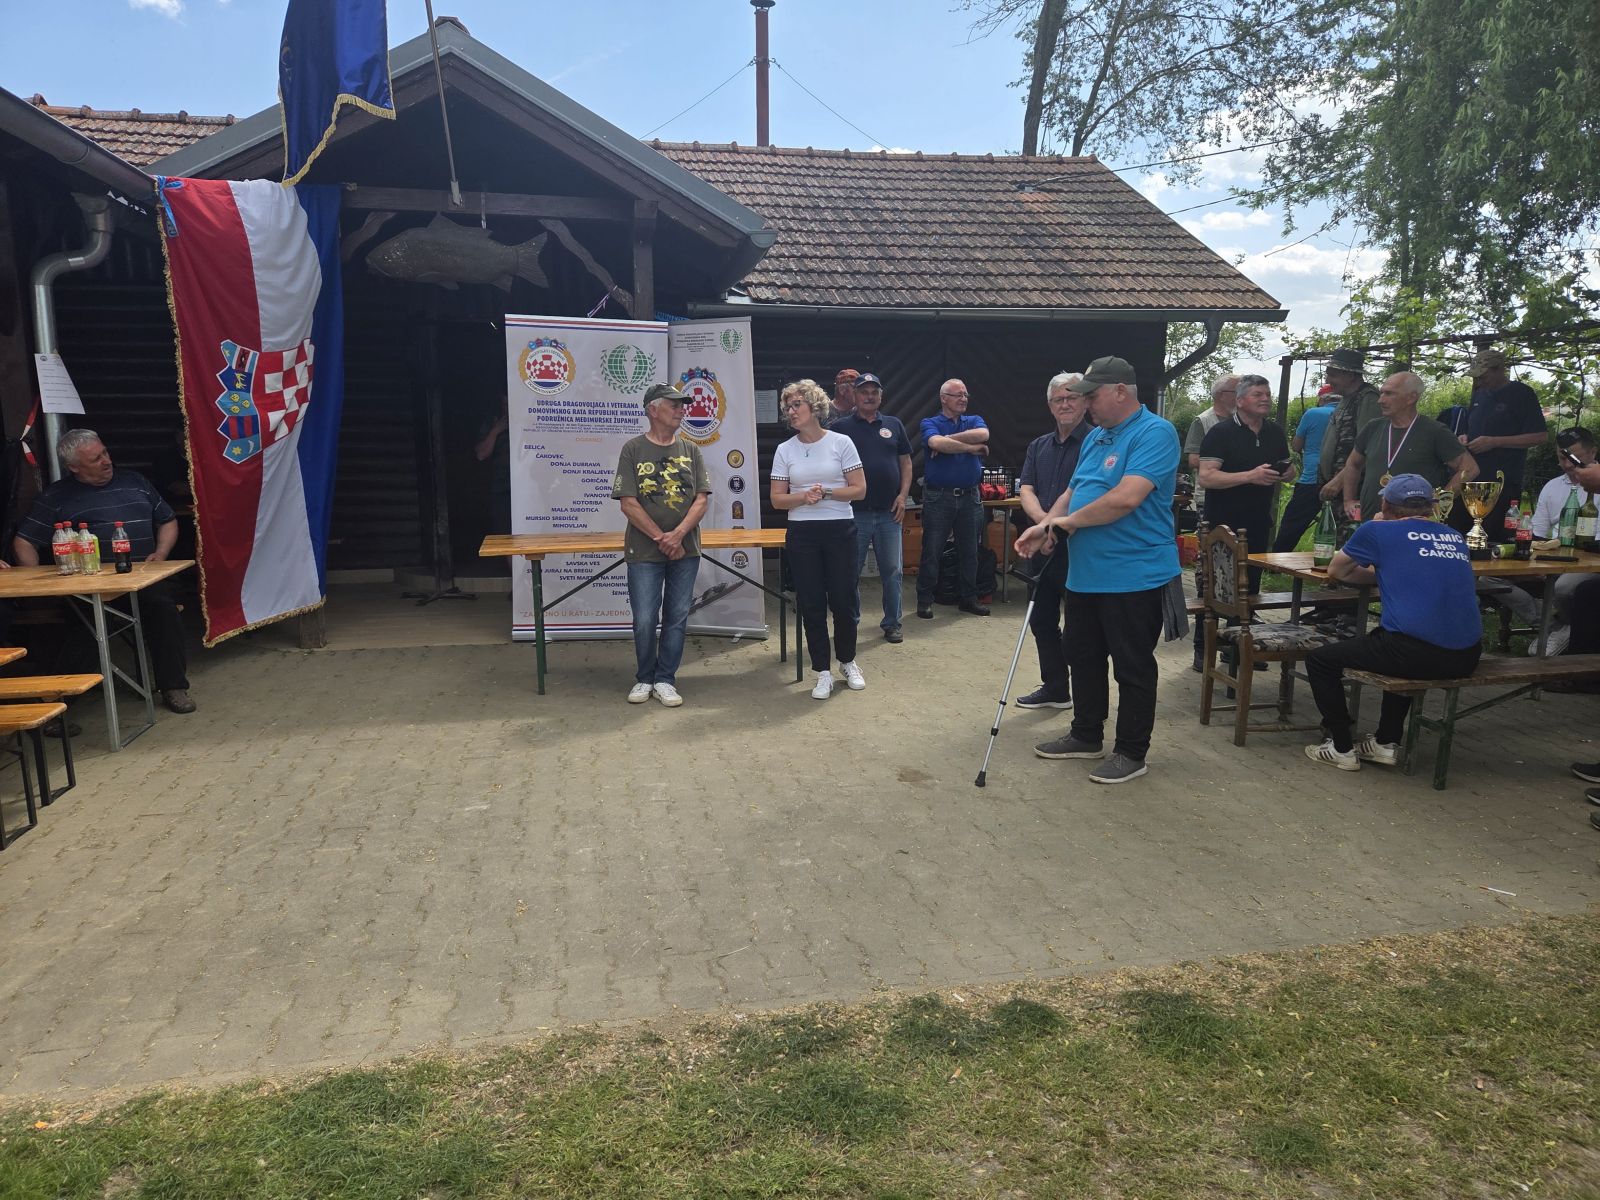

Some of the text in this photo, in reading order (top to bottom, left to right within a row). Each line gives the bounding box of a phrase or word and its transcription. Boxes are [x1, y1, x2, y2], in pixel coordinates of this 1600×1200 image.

[536, 399, 561, 407] UDRUGA
[562, 400, 606, 409] DRAGOVOLJACA
[528, 407, 571, 415] DOMOVINSKOG
[536, 414, 574, 423] PODRUŽNICA
[613, 416, 639, 425] ŽUPANIJE
[636, 461, 655, 476] 20
[1407, 531, 1463, 544] COLMIC
[1433, 541, 1457, 551] ŠRD
[595, 609, 631, 617] ZAJEDNO
